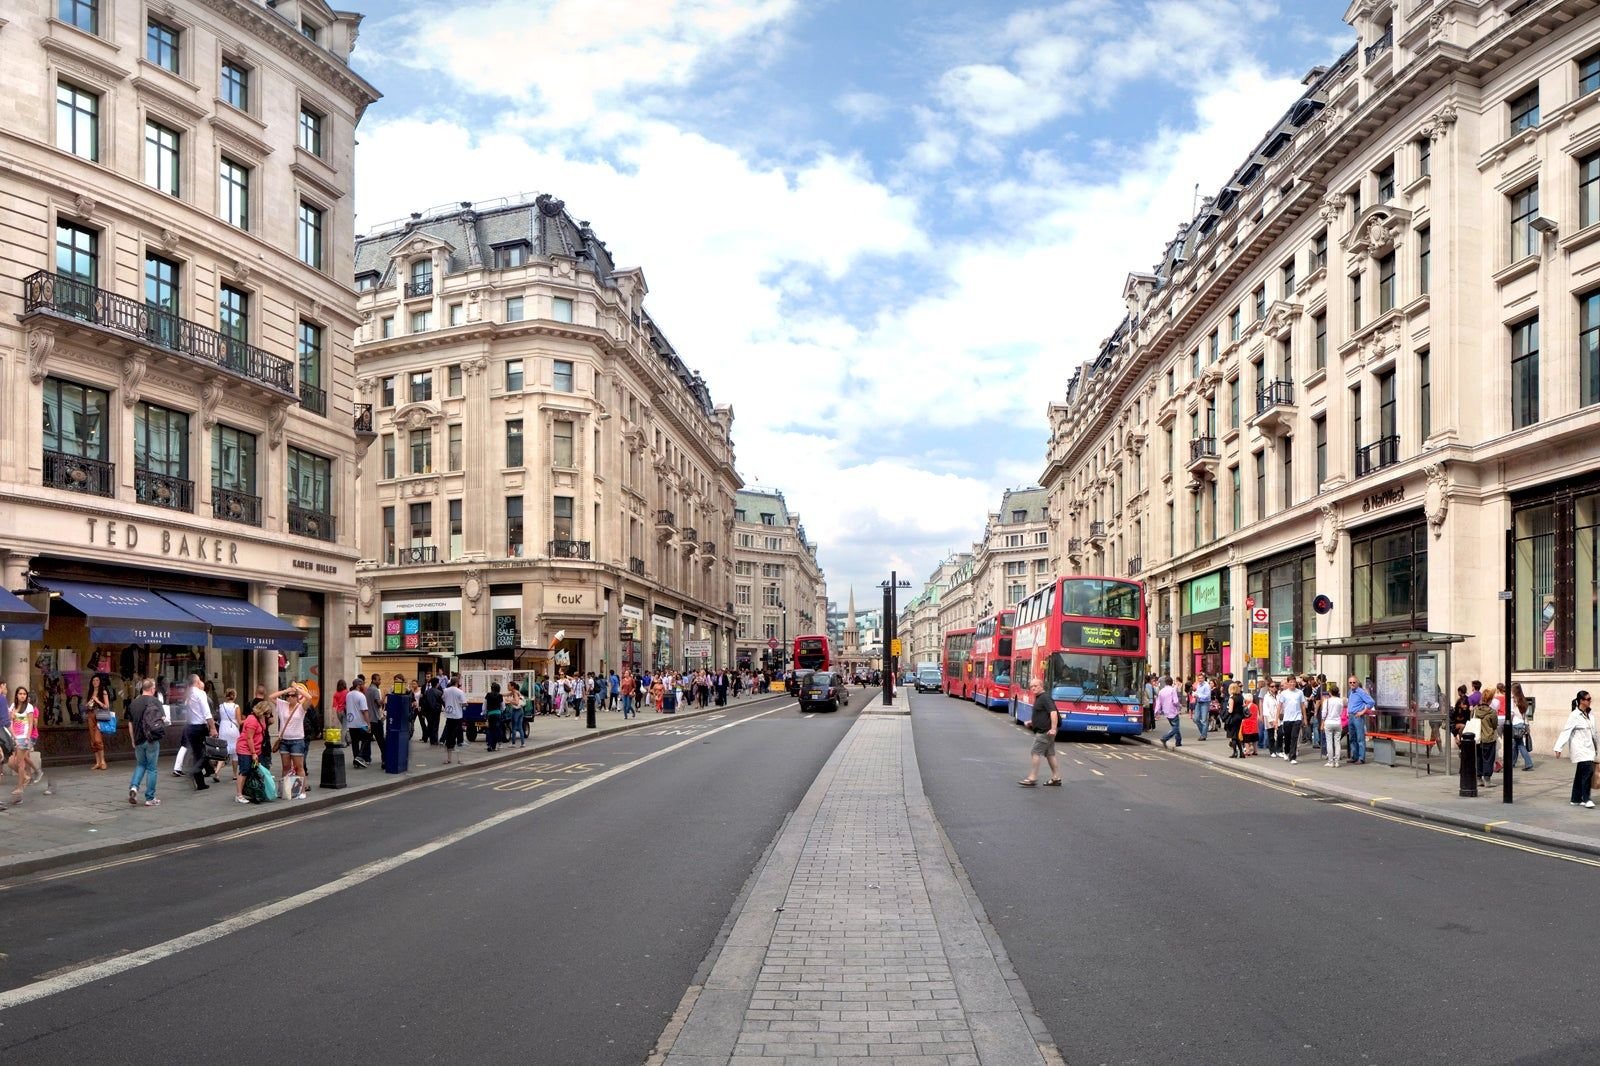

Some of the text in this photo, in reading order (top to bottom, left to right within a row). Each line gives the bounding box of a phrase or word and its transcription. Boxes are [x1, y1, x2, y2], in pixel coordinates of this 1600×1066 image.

[1371, 486, 1404, 509] NatWest
[88, 518, 238, 564] TED BAKER
[557, 593, 582, 604] fcuk
[497, 616, 511, 624] END
[134, 630, 147, 638] TED
[1114, 629, 1120, 637] 6
[1088, 637, 1115, 645] Aldwych
[505, 762, 606, 774] BUS
